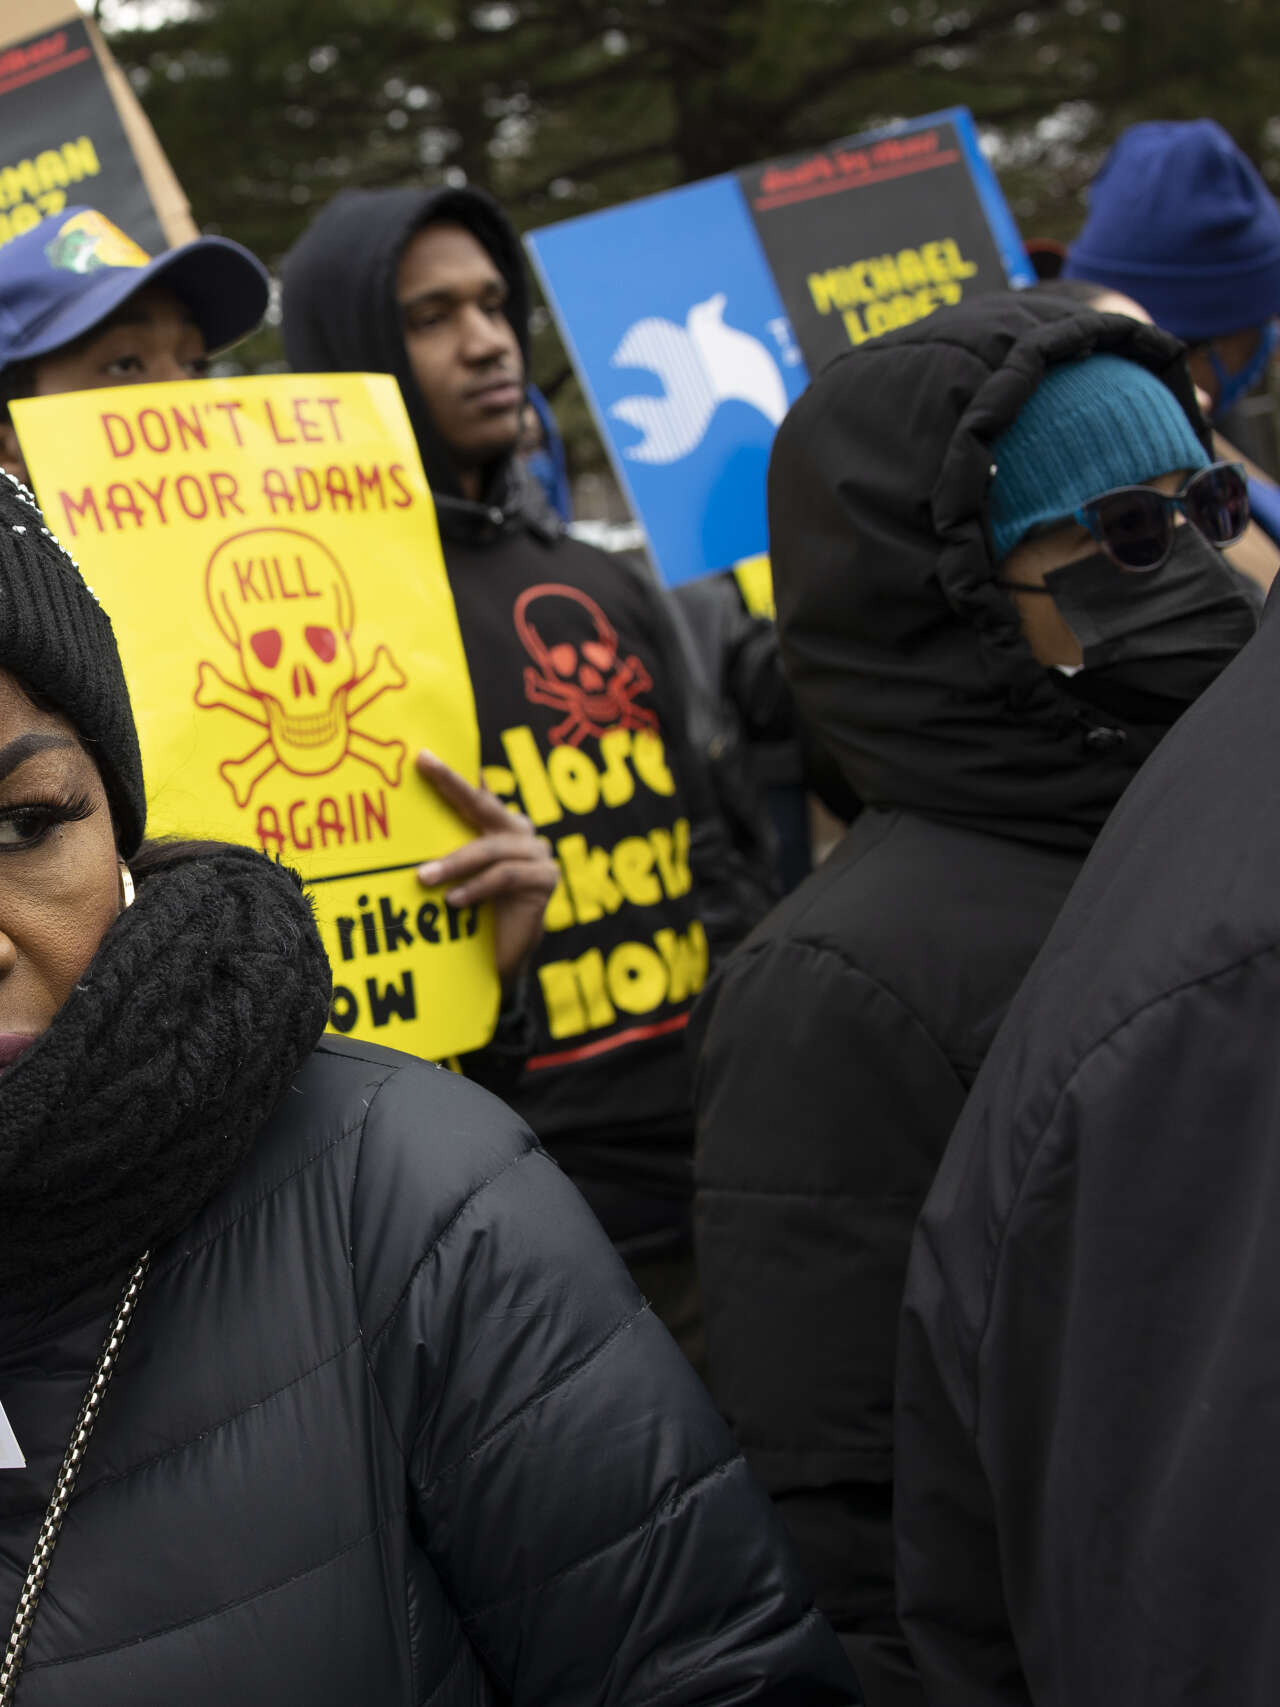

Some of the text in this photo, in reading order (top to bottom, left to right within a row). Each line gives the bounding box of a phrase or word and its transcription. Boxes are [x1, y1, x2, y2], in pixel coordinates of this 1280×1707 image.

[807, 237, 978, 316] MICHAEL
[100, 397, 346, 458] DON'T LET
[58, 463, 412, 536] MAYOR ADAMS
[233, 556, 322, 603] KILL
[256, 789, 390, 853] AGAIN
[329, 970, 418, 1034] ow
[538, 920, 709, 1040] now
